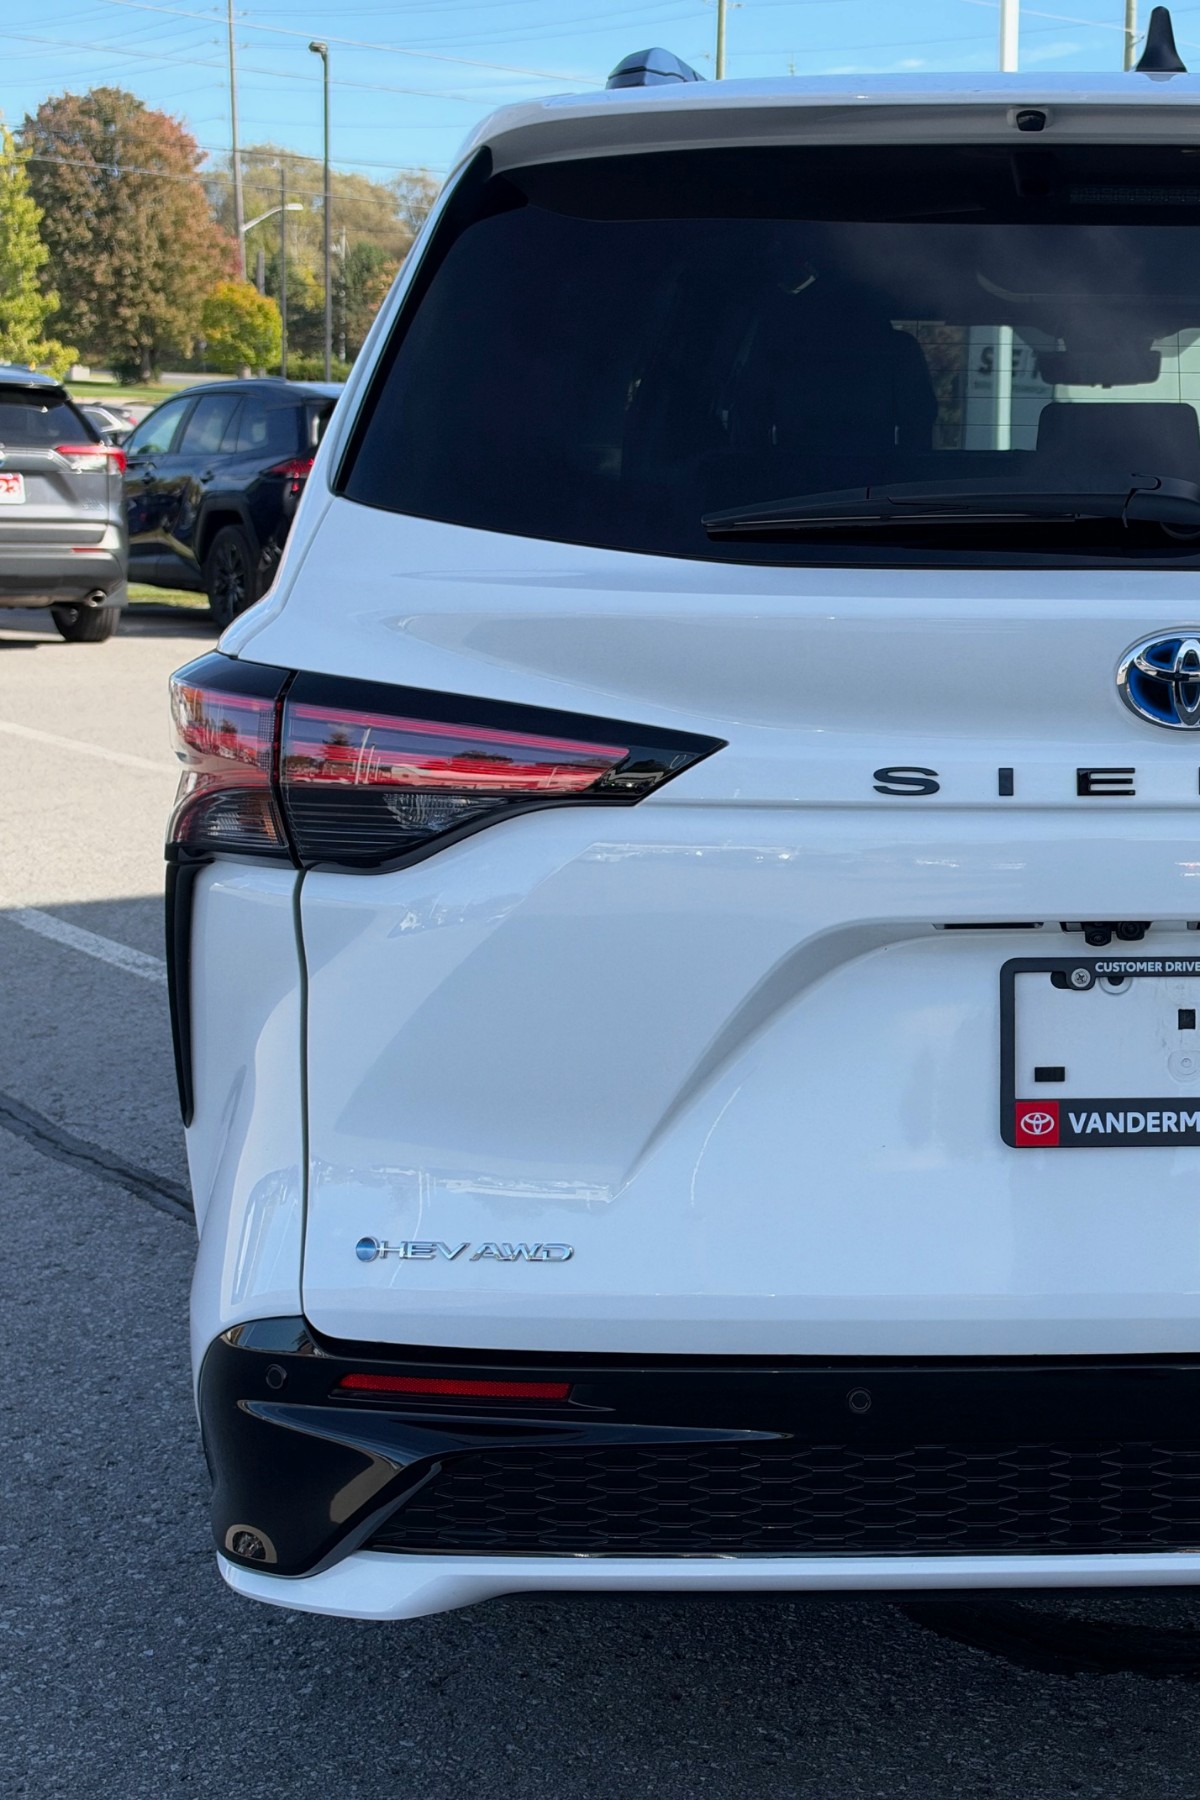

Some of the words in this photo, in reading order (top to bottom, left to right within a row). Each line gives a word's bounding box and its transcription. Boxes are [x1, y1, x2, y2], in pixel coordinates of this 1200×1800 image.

[1095, 961, 1162, 972] CUSTOMER
[379, 1240, 471, 1261] HEV
[469, 1242, 574, 1262] AWD
